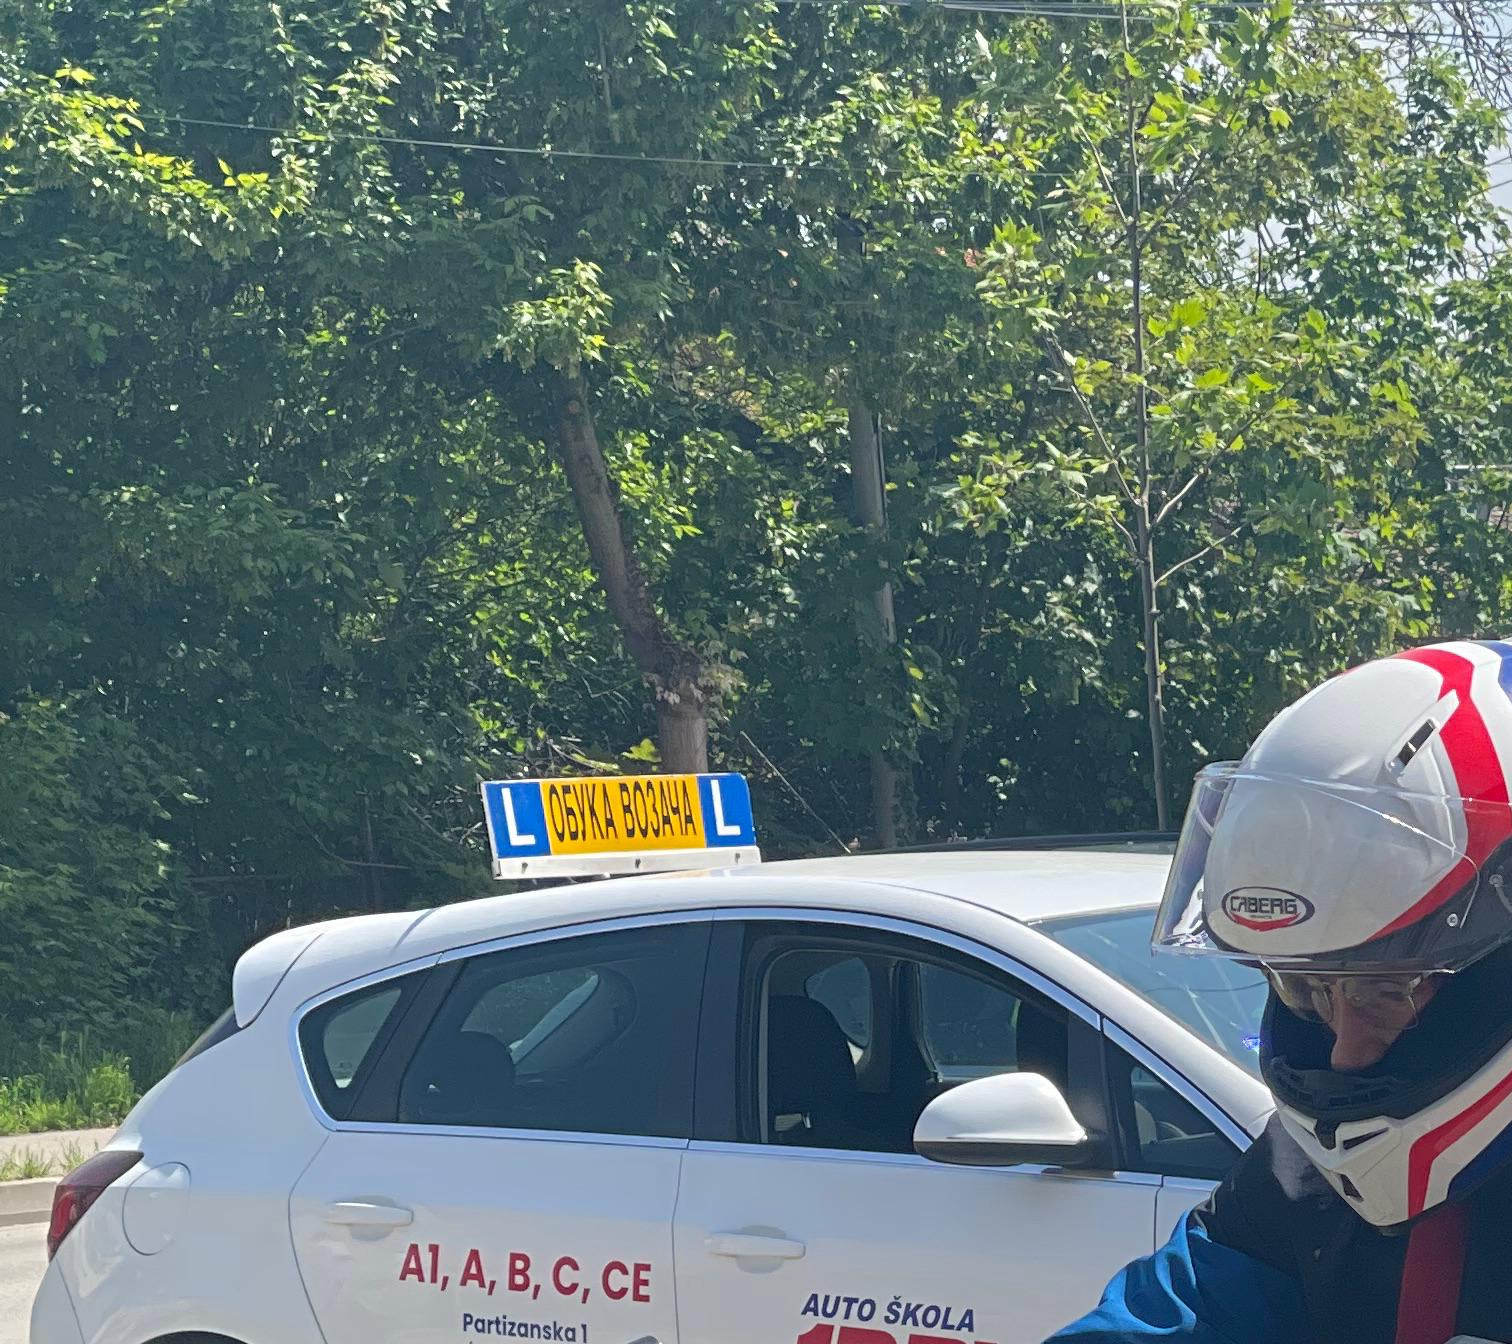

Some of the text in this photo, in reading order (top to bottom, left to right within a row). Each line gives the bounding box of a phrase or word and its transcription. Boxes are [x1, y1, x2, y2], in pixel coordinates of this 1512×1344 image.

[500, 787, 536, 847] L
[549, 780, 697, 842] ОБУКА ВОЗАЧА
[710, 779, 742, 836] L
[1229, 895, 1298, 915] CABERG
[398, 1243, 652, 1304] A1, A, B, C, CE
[462, 1312, 588, 1344] Partizanska 1
[801, 1292, 975, 1333] AUTO ŠKOLA
